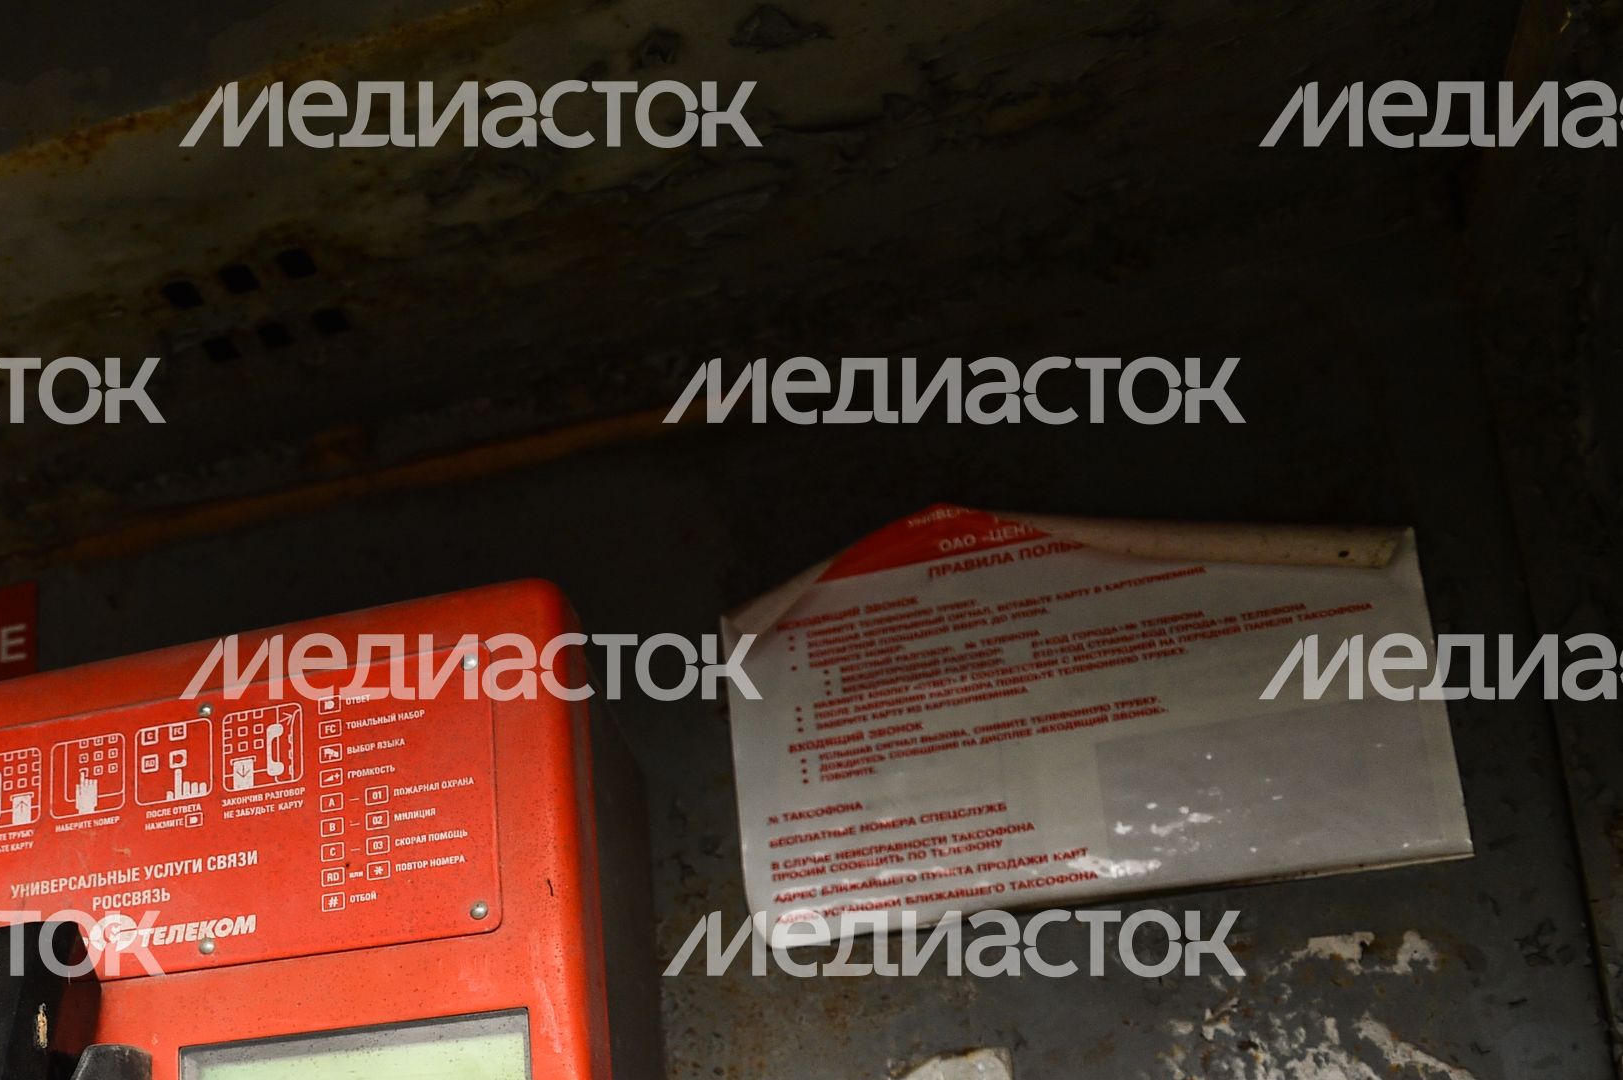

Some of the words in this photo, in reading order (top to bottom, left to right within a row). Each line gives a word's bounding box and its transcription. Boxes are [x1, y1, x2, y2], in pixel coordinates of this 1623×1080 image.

[937, 534, 977, 553] ОАО
[927, 551, 1015, 578] ПРАВИЛА
[1056, 586, 1089, 601] КАРТУ
[1297, 602, 1373, 622] ТАКСОФОНА
[345, 693, 371, 706] ОТВЕТ
[346, 713, 397, 730] ТОНАЛЬНЫЙ
[397, 709, 426, 722] НАБОР
[324, 724, 337, 735] FC
[788, 730, 864, 753] ВХОДЯЩИЙ
[868, 720, 923, 739] ЗВОНОК
[346, 742, 376, 755] ВЫБОР
[377, 738, 406, 750] ЯЗЫКА
[347, 764, 396, 779] ГРОМКОСТЬ
[372, 791, 383, 801] 01
[393, 781, 440, 797] ПОЖАРНАЯ
[441, 776, 475, 790] ОХРАНА
[221, 794, 264, 808] ЗАКОНЧИВ
[264, 787, 306, 801] РАЗГОВОР
[328, 798, 335, 808] A
[145, 808, 171, 819] ПОСЛЕ
[172, 803, 203, 815] ОТВЕТА
[223, 810, 234, 820] НЕ
[235, 804, 275, 818] ЗАБУДЬТЕ
[277, 799, 304, 812] КАРТУ
[394, 808, 436, 822] МИЛИЦИЯ
[782, 801, 864, 823] ТАКСОФОНА
[55, 820, 92, 833] НАБЕРИТЕ
[93, 815, 121, 828] НОМЕР
[144, 817, 184, 831] НАЖМИТЕ
[329, 822, 336, 832] B
[372, 815, 383, 825] 02
[769, 826, 857, 849] БЕСПЛАТНЫЕ
[860, 816, 918, 835] НОМЕРА
[920, 801, 1008, 825] СПЕЦСЛУЖБ
[10, 841, 34, 852] КАРТУ
[372, 840, 384, 850] 03
[394, 834, 427, 847] СКОРАЯ
[428, 828, 468, 842] ПОМОЩЬ
[771, 861, 780, 871] В
[783, 853, 832, 869] СЛУЧАЕ
[835, 836, 948, 861] НЕИСПРАВНОСТИ
[951, 821, 1036, 843] ТАКСОФОНА
[330, 847, 336, 857] C
[772, 866, 827, 882] ПРОСИМ
[830, 855, 905, 875] СООБЩИТЬ
[908, 849, 927, 861] ПО
[931, 838, 1004, 858] ТЕЛЕФОНУ
[395, 860, 428, 873] ПОВТОР
[429, 854, 466, 868] НОМЕРА
[10, 866, 140, 899] УНИВЕРСАЛЬНЫЕ
[143, 857, 203, 881] УСЛУГИ
[206, 849, 258, 871] СВЯЗИ
[326, 872, 340, 882] RD
[773, 889, 818, 904] АДРЕС
[820, 873, 918, 897] БЛИЖАЙШЕГО
[921, 865, 975, 882] ПУНКТА
[977, 853, 1049, 873] ПРОДАЖИ
[1053, 846, 1089, 861] КАРТ
[92, 887, 171, 911] РОССВЯЗЬ
[349, 890, 377, 904] ОТБОЙ
[822, 898, 902, 918] УСТАНОВКИ
[905, 882, 1006, 906] БЛИЖАЙШЕГО
[1009, 869, 1099, 891] ТАКСОФОНА
[137, 914, 257, 948] ТЕЛЕКОМ
